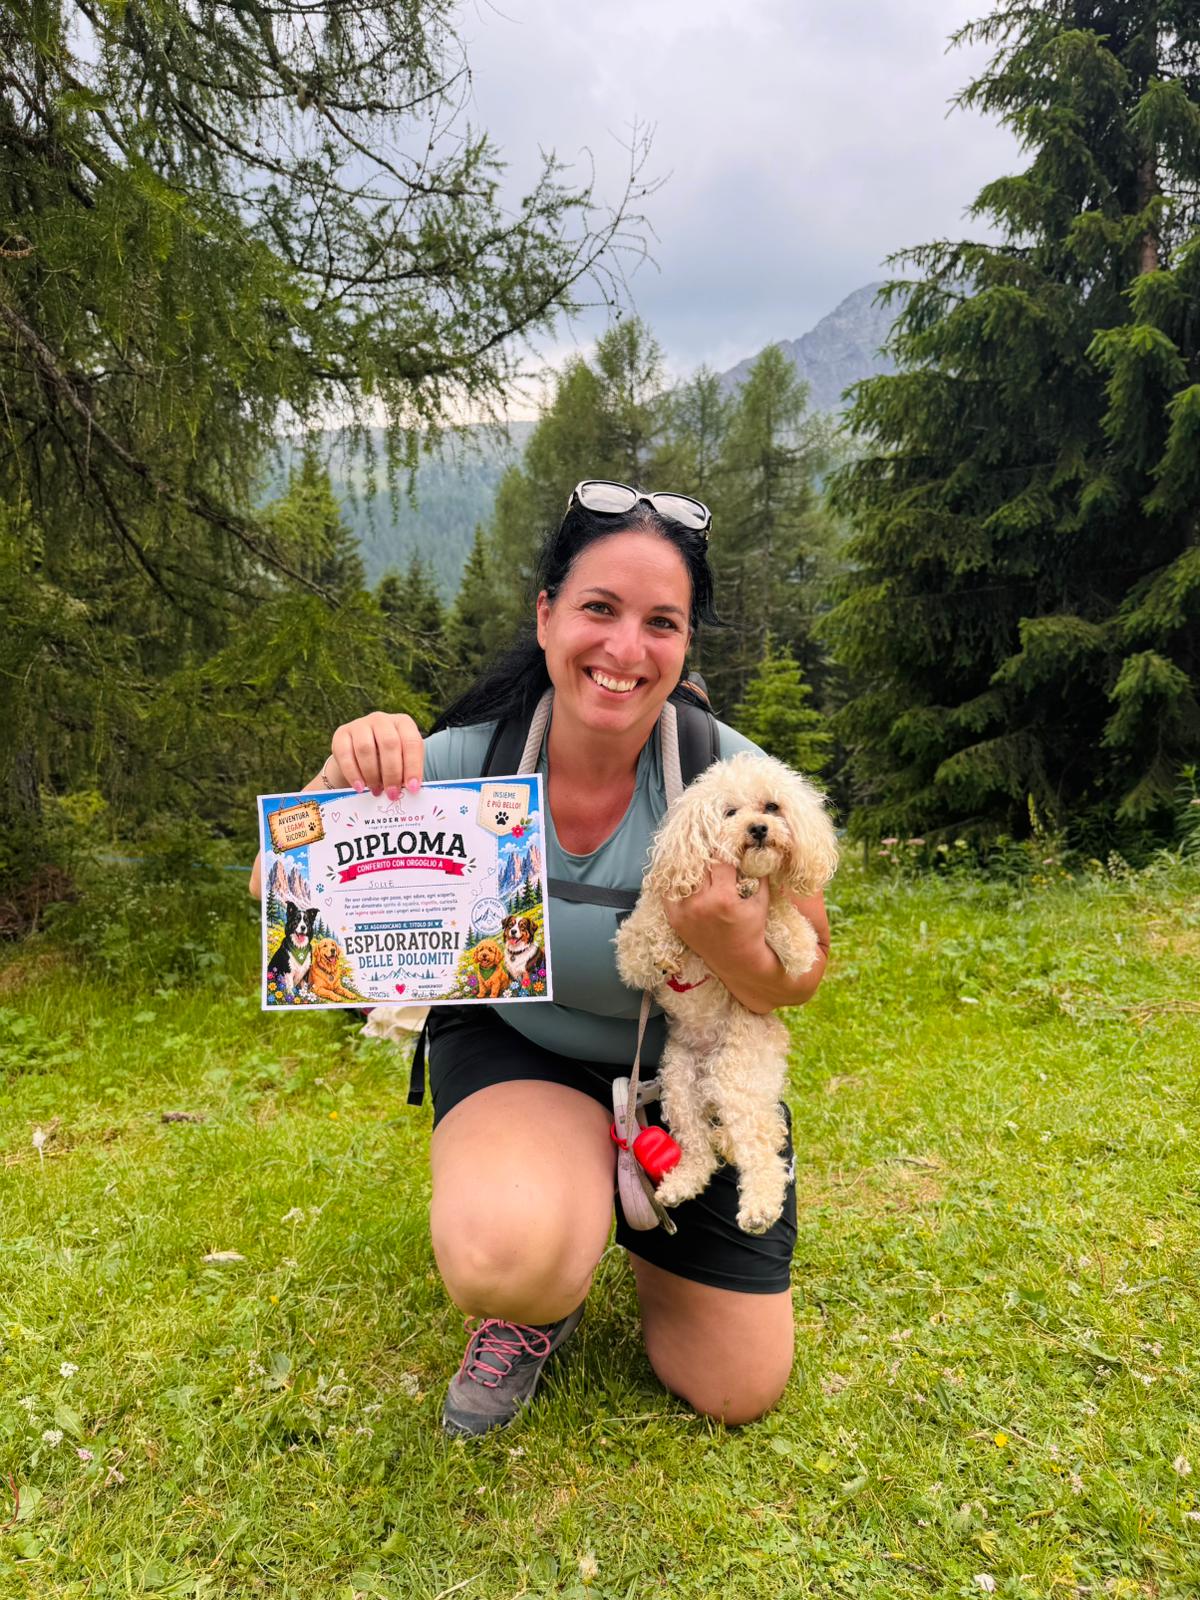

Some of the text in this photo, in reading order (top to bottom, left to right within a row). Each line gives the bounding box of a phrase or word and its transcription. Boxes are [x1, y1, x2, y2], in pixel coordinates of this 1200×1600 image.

[493, 791, 516, 799] INSIEME
[502, 801, 522, 809] BELLO!
[278, 811, 309, 826] AVVENTURA
[364, 815, 425, 825] WANDERWOOF
[284, 821, 305, 833] LEGAMI
[286, 830, 308, 842] RICORDI
[334, 830, 468, 866] DIPLOMA
[357, 860, 391, 873] CONFERITO
[392, 859, 405, 868] CON
[406, 859, 438, 868] ORGOGLIO
[344, 931, 460, 955] ESPLORATORI
[358, 952, 454, 969] DELLE DOLOMITI
